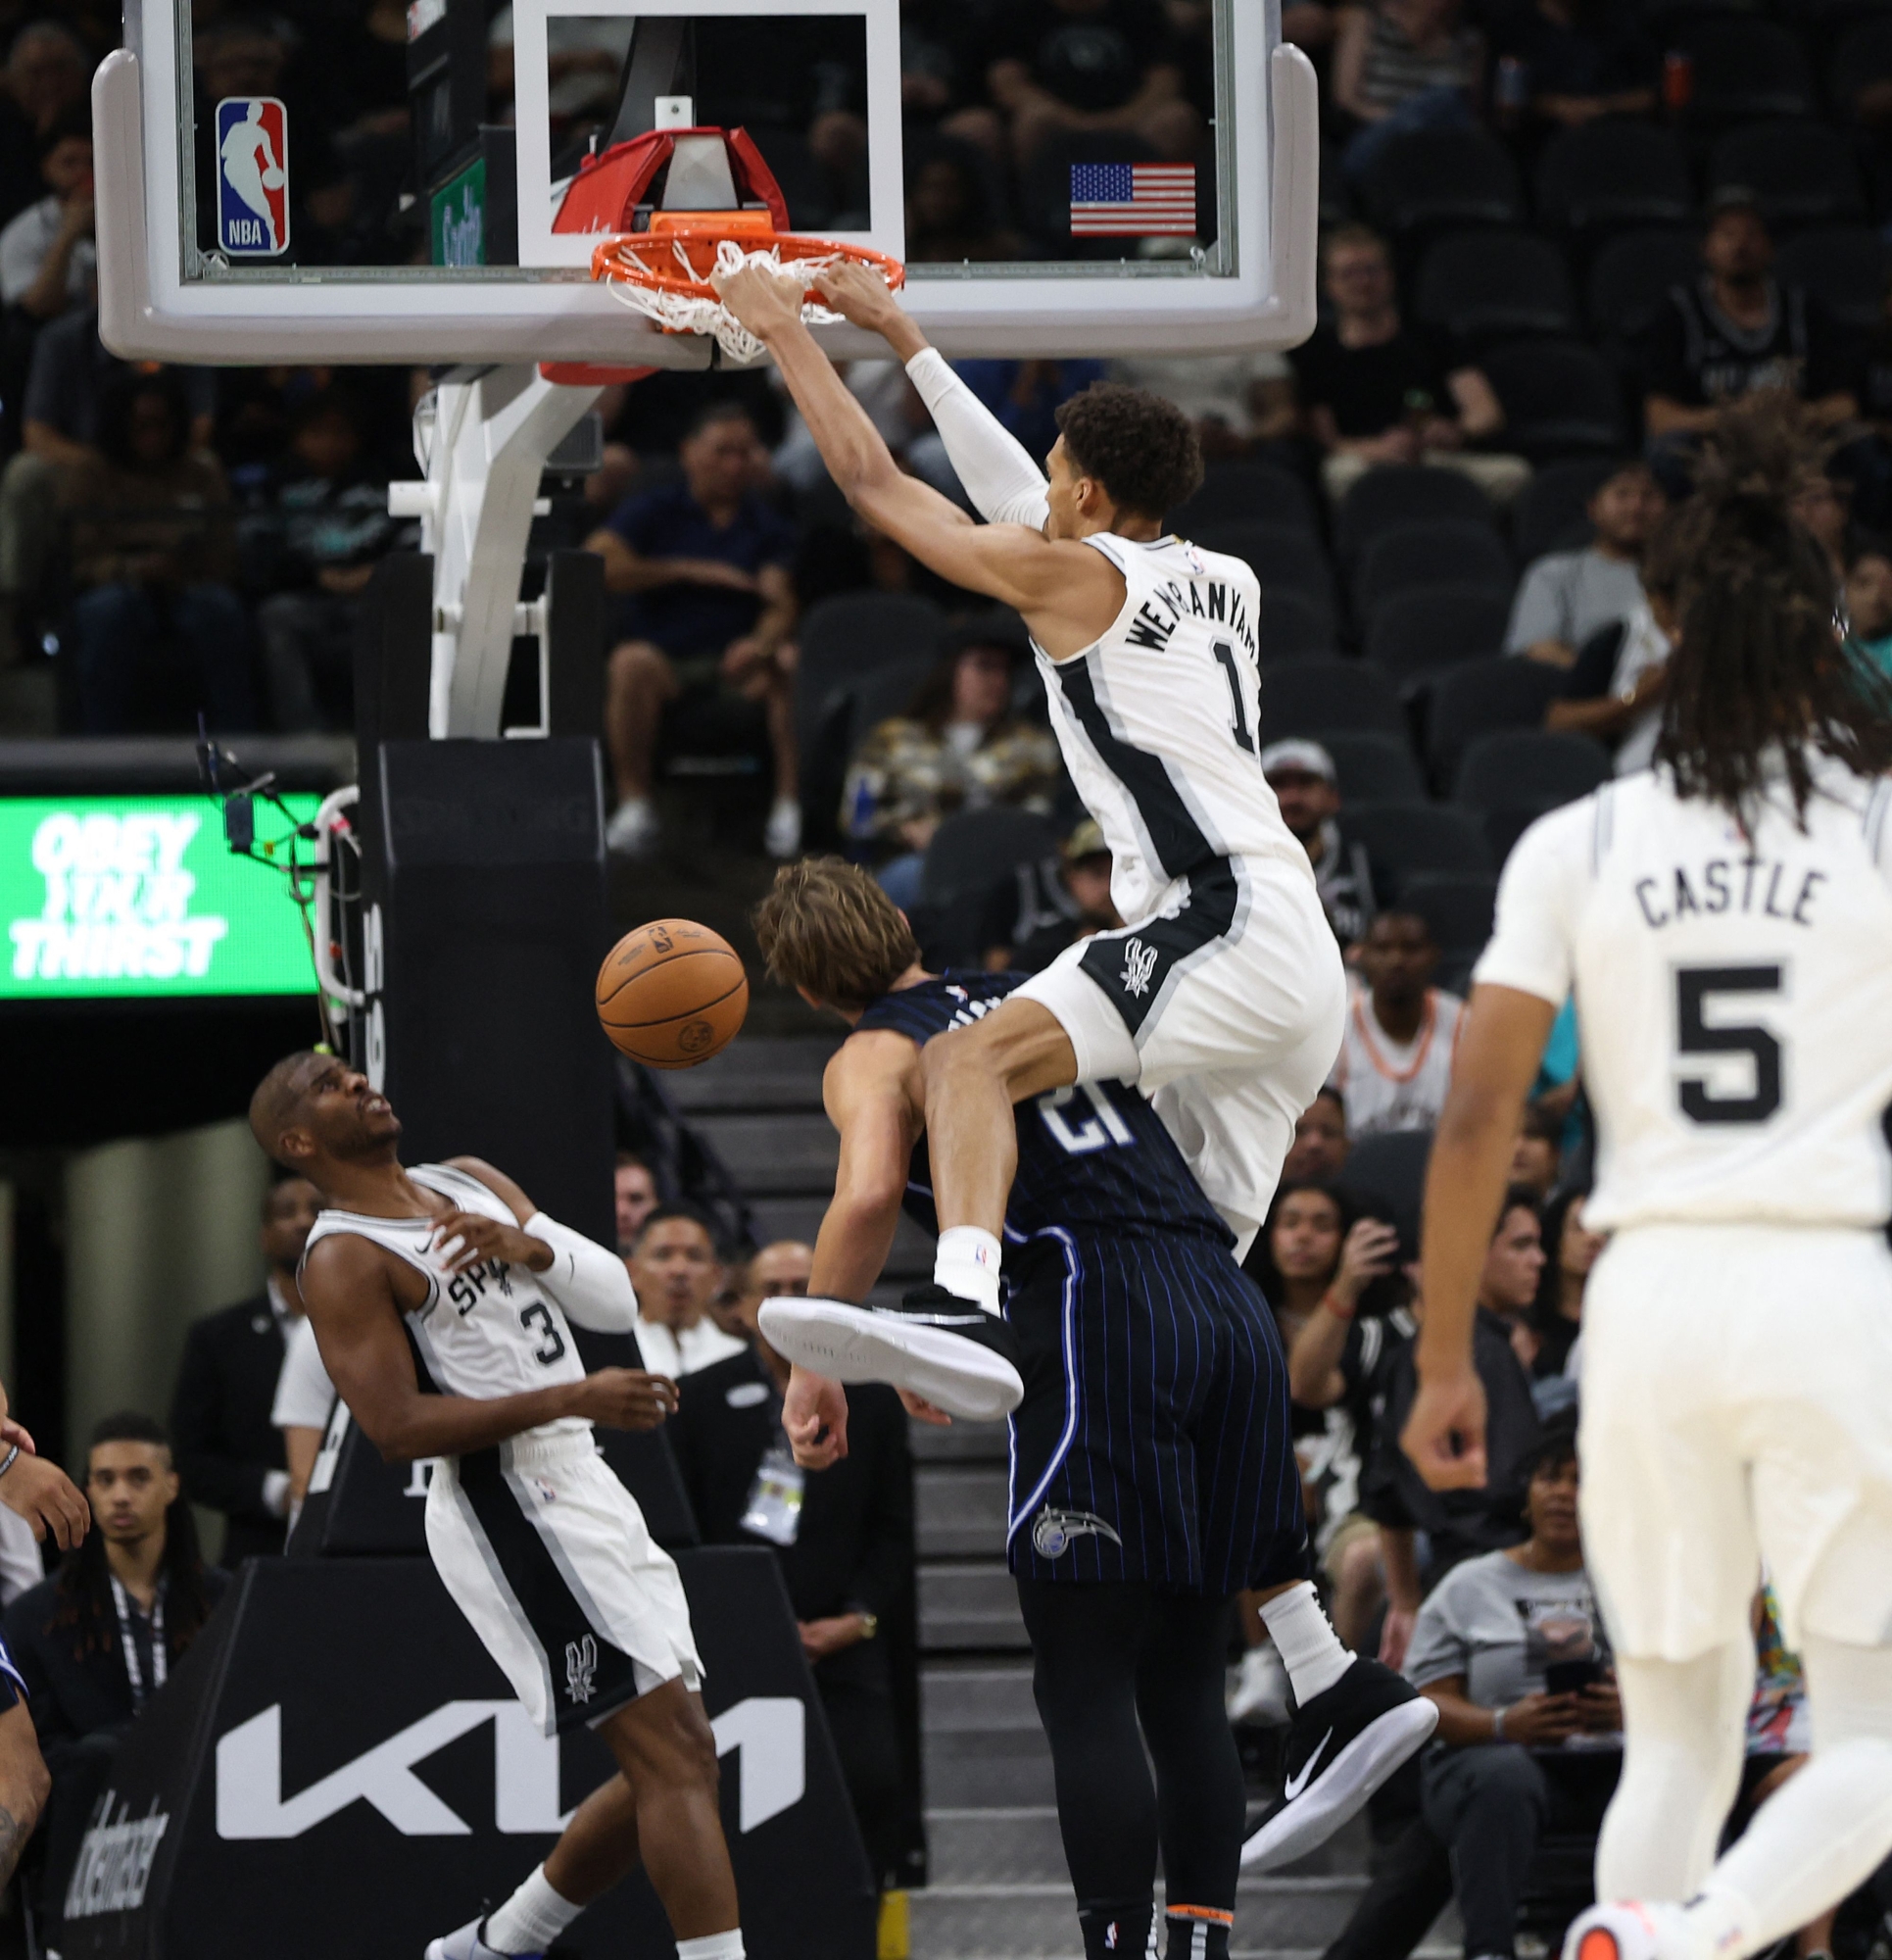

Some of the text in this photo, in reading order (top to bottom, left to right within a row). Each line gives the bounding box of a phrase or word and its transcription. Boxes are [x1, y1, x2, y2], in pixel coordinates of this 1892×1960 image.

[227, 218, 263, 246] NBA
[1211, 640, 1257, 756] 1
[33, 814, 198, 874] OBEY
[1635, 858, 1827, 930] CASTLE
[11, 919, 226, 978] THIRST
[1673, 962, 1785, 1126] 5
[519, 1300, 566, 1365] 3
